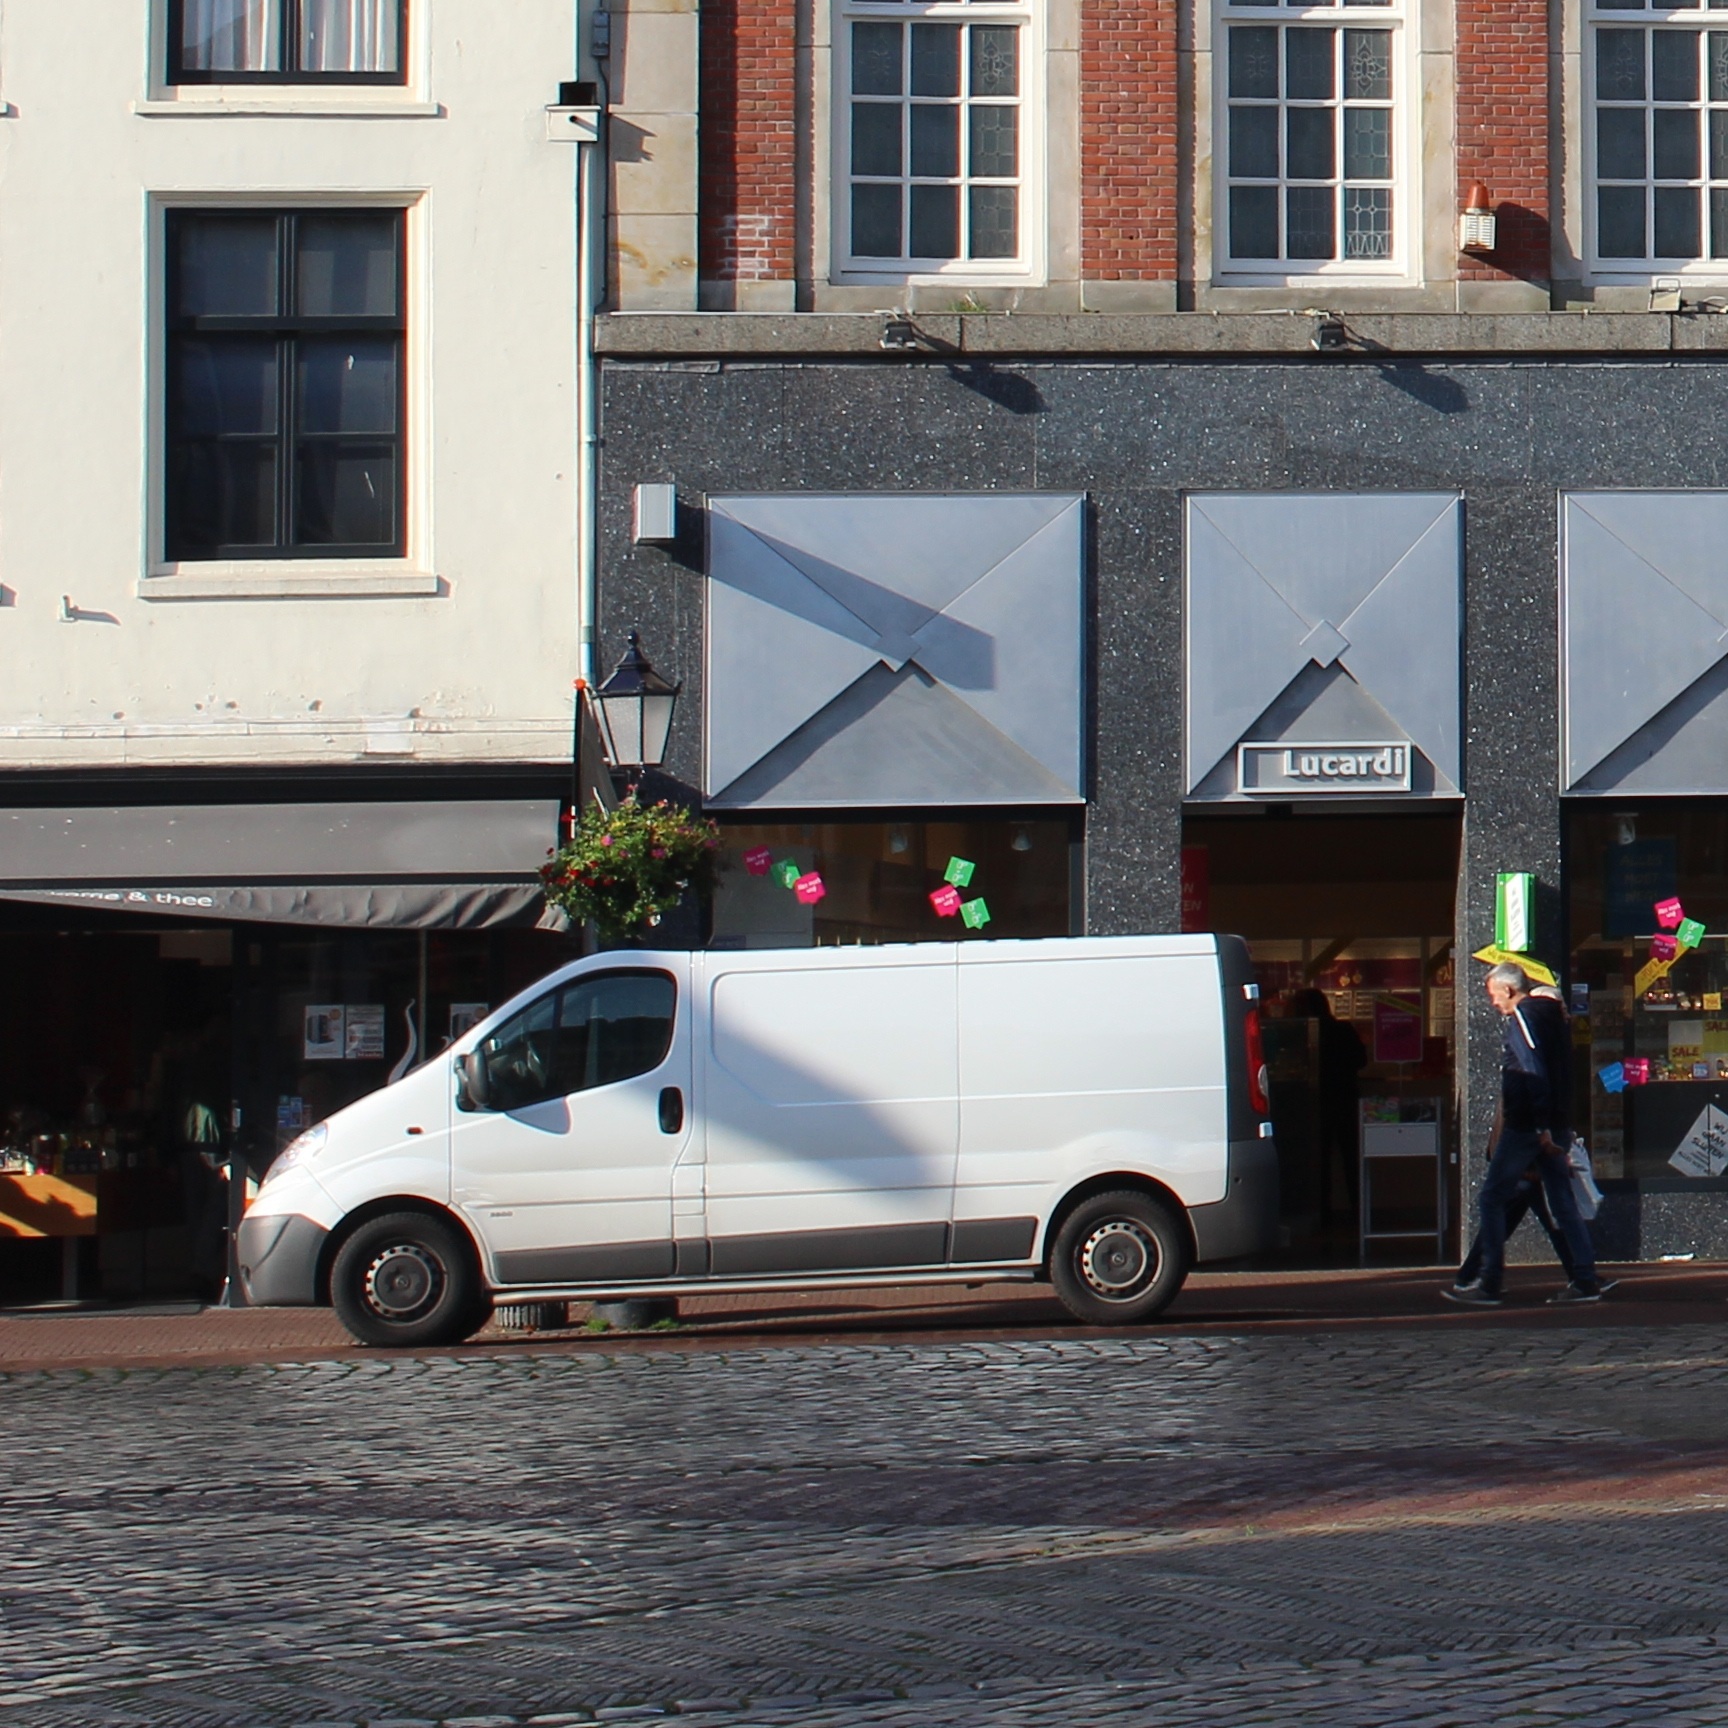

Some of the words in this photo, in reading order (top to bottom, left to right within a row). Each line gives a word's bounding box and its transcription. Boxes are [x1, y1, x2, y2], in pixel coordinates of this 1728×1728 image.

[1283, 747, 1404, 776] Lucardi
[155, 893, 214, 908] thee
[1671, 1046, 1700, 1058] SALE
